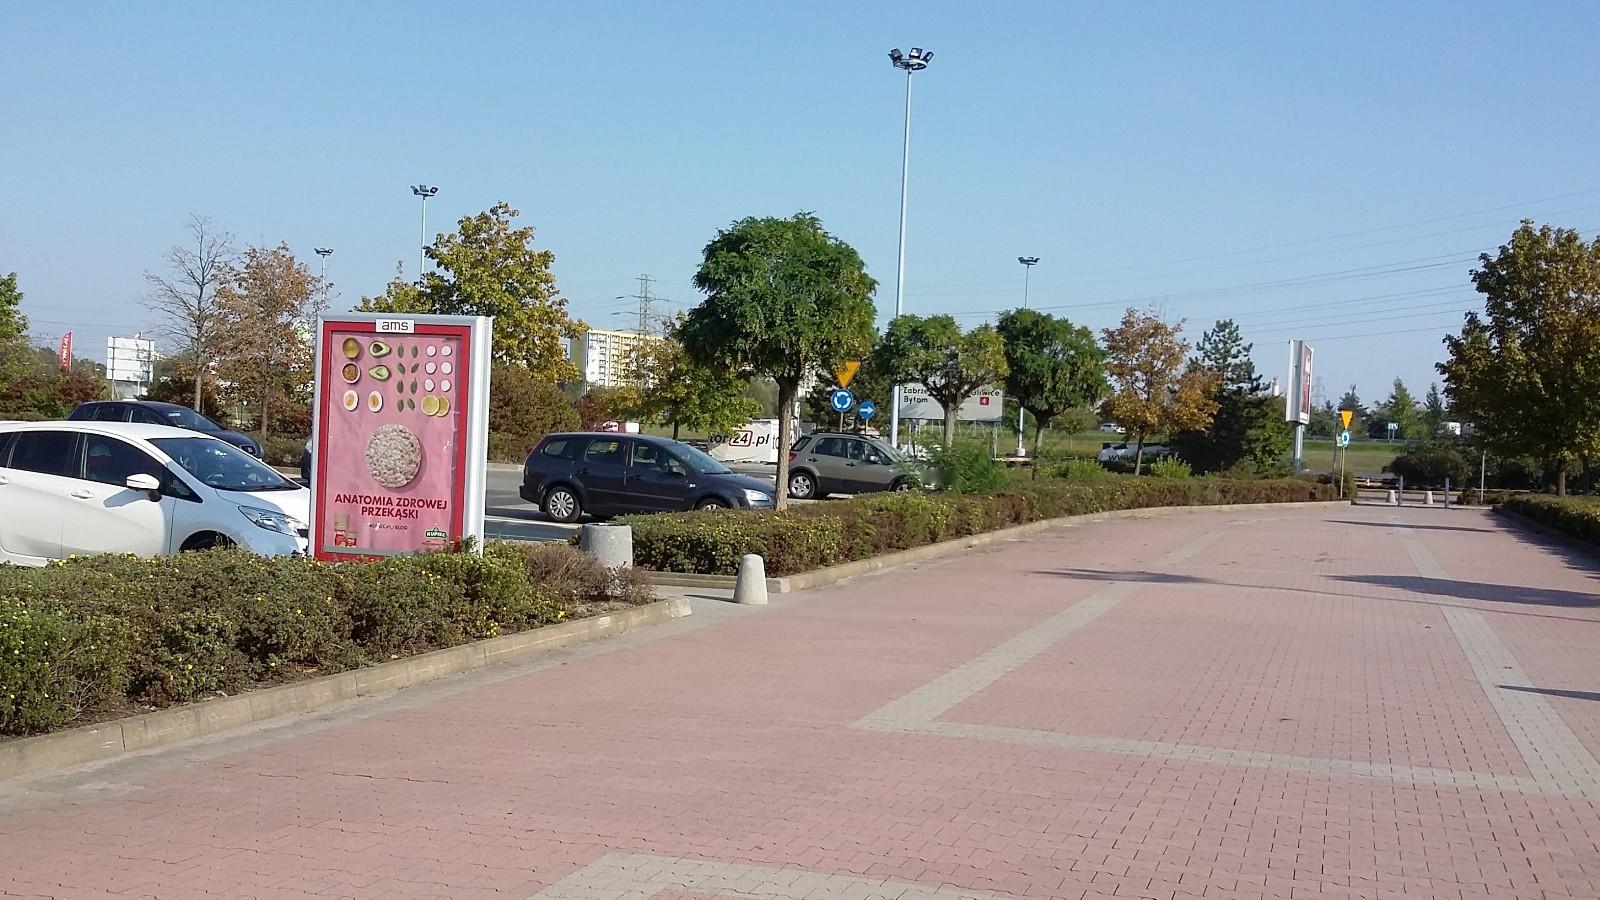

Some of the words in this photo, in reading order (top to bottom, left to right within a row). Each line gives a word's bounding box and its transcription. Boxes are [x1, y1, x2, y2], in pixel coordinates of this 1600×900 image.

[381, 321, 409, 331] ams
[903, 395, 928, 405] Bytom
[335, 494, 393, 506] ANATOMIA
[396, 498, 447, 509] ZDROWEJ
[361, 507, 418, 520] PRZEKĄSKI
